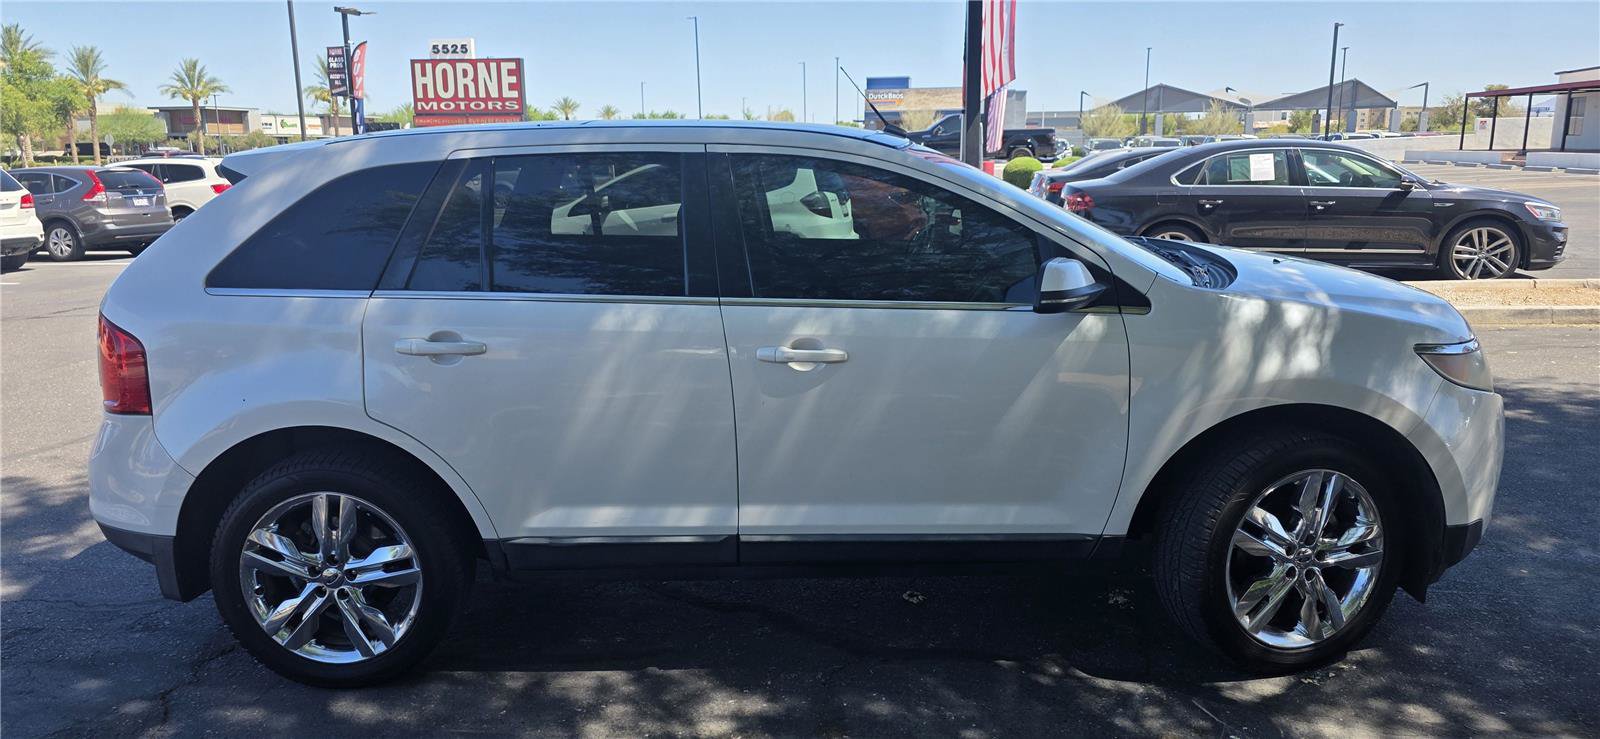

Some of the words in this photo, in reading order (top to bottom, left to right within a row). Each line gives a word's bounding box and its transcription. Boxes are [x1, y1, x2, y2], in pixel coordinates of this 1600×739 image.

[432, 44, 468, 54] 5525
[414, 61, 518, 99] HORNE
[417, 101, 519, 110] MOTORS
